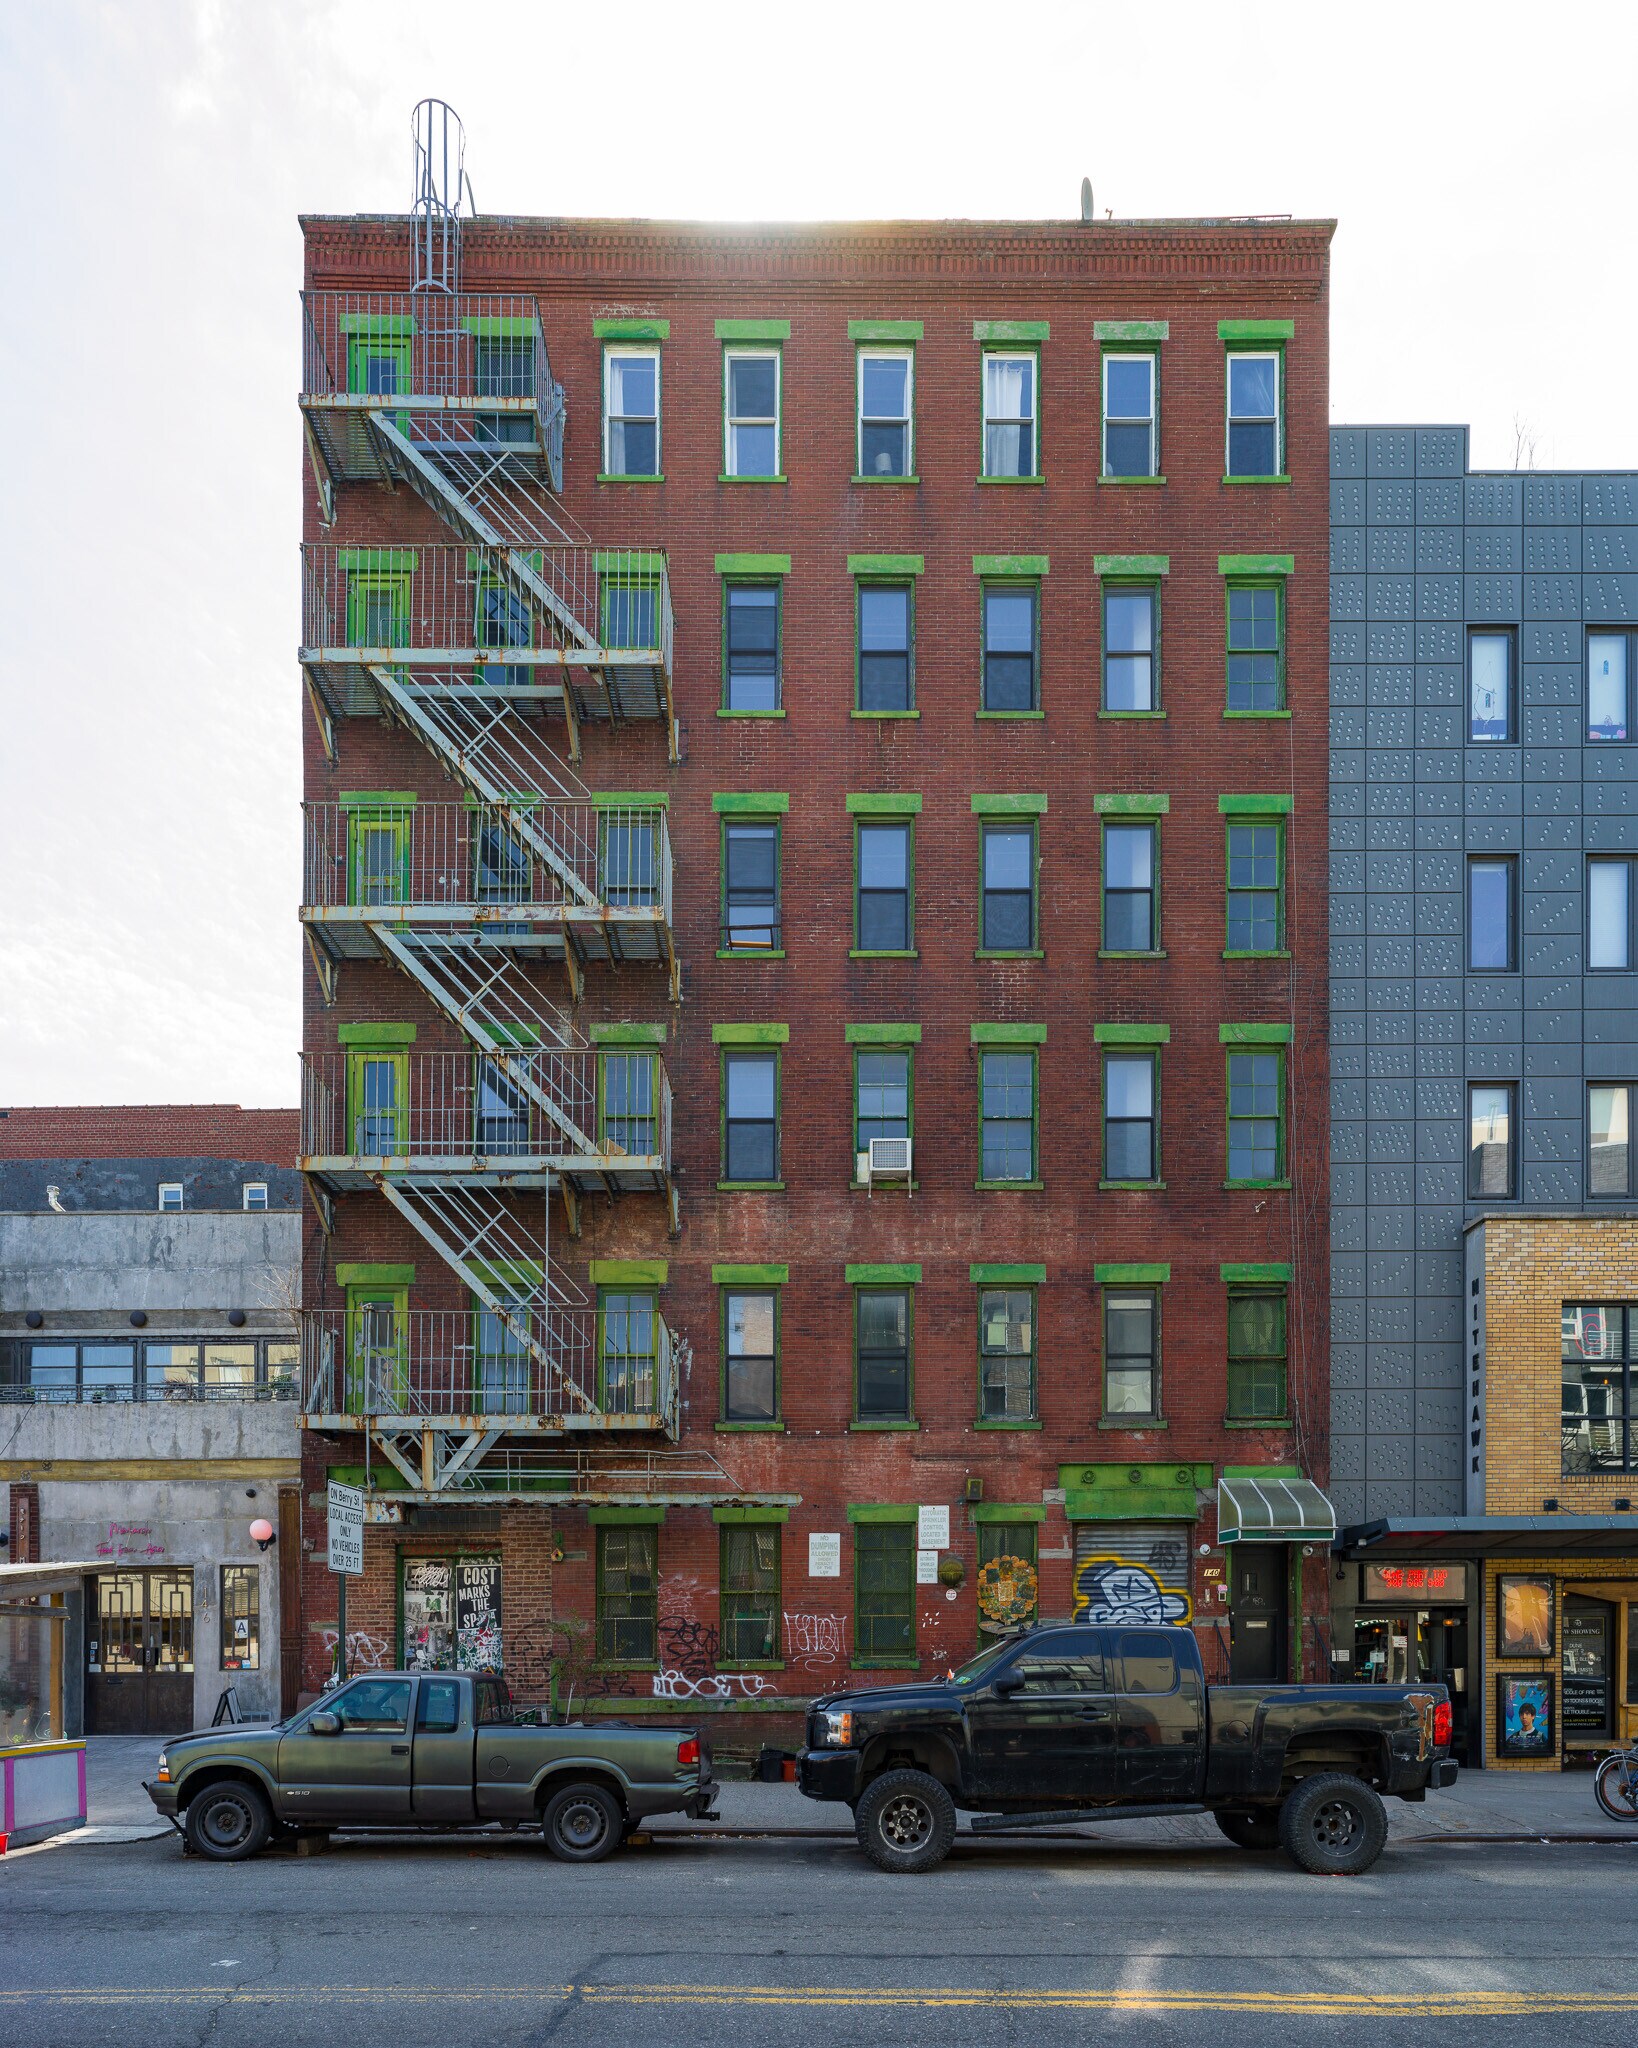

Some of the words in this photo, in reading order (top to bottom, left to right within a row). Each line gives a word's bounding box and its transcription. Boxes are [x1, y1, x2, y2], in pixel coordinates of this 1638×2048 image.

[330, 1487, 338, 1499] ON
[339, 1490, 353, 1506] Berry
[329, 1507, 344, 1522] LOCAL
[345, 1511, 362, 1526] ACCESS
[340, 1525, 352, 1538] ONLY
[331, 1538, 338, 1551] NO
[339, 1540, 360, 1554] VEHICLES
[810, 1541, 839, 1551] DUMPING
[332, 1553, 345, 1567] OVER
[345, 1556, 352, 1567] 25
[353, 1557, 359, 1569] FT
[463, 1567, 497, 1585] COST
[458, 1585, 491, 1601] MARKS
[471, 1598, 490, 1611] THE
[237, 1621, 246, 1634] A
